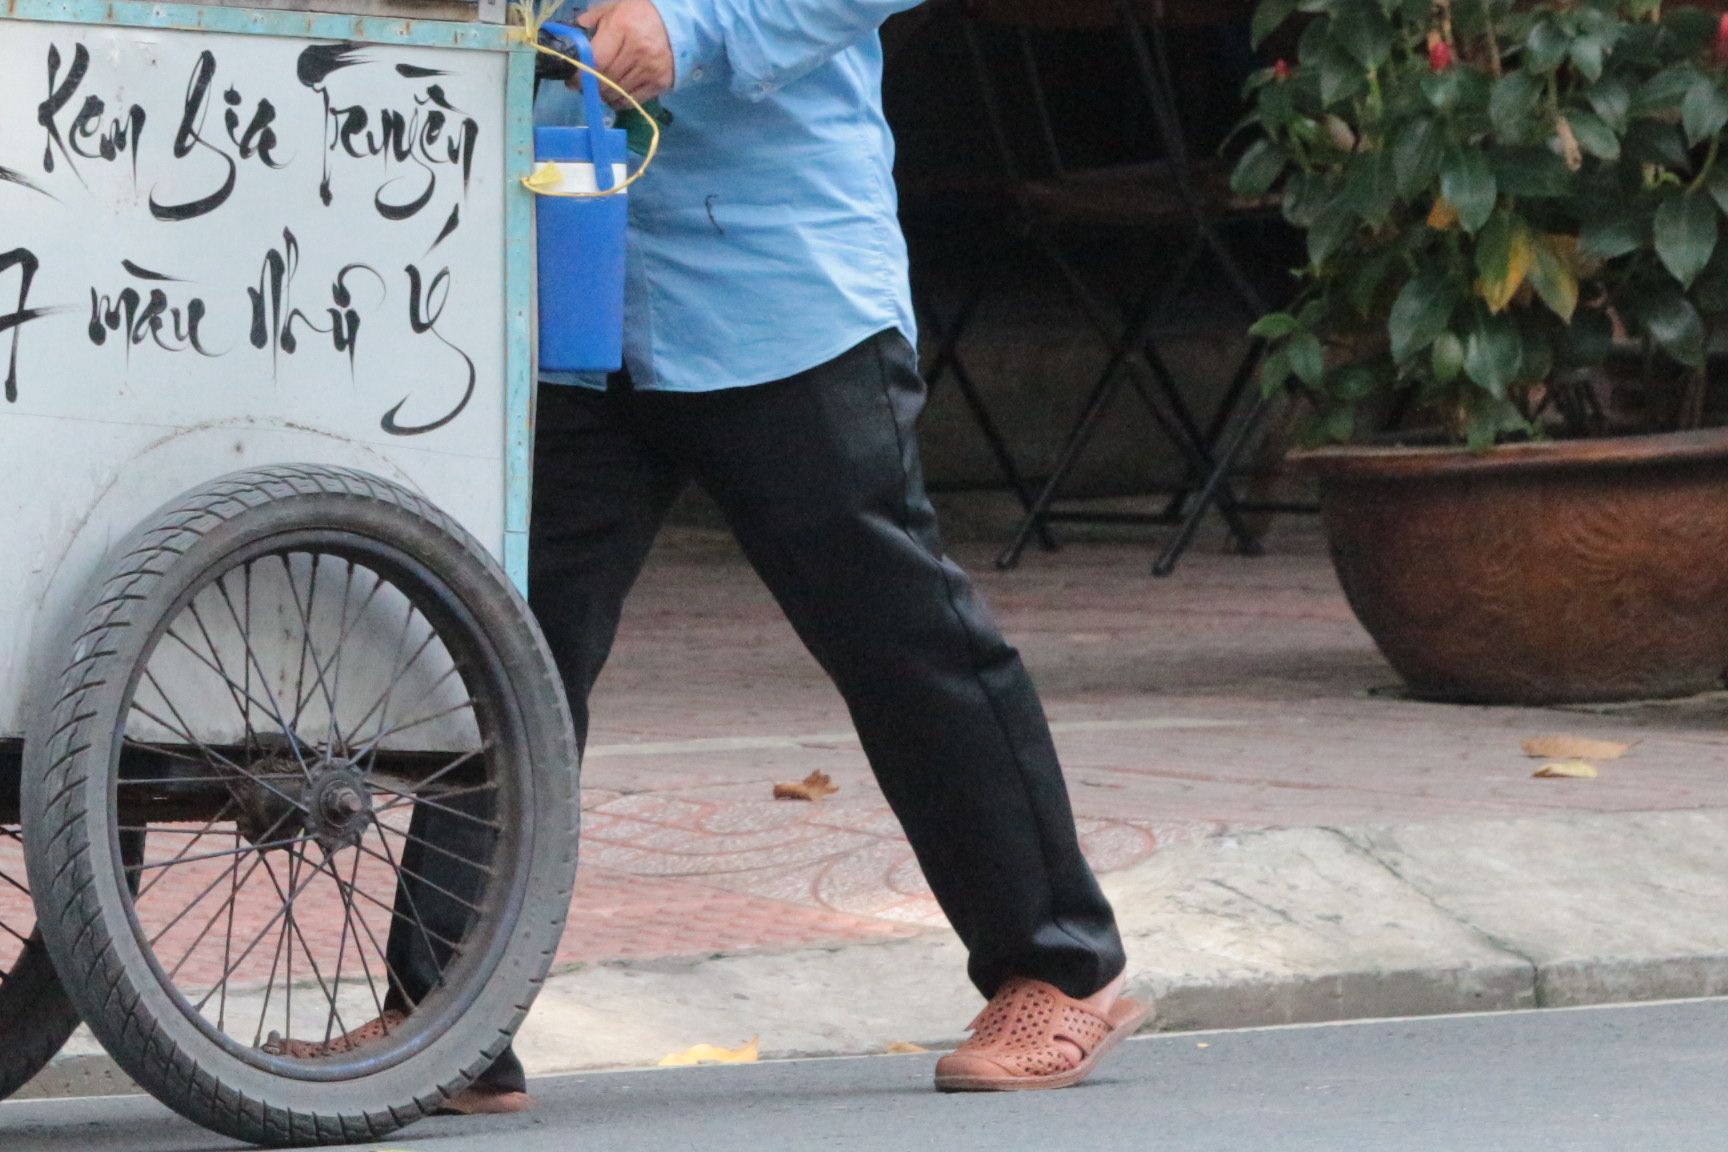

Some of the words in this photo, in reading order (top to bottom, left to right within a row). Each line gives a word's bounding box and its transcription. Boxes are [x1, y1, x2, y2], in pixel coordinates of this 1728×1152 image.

[38, 42, 146, 189] Kem
[149, 50, 292, 221] Gia
[297, 44, 478, 221] Truyền
[247, 226, 386, 386] Như
